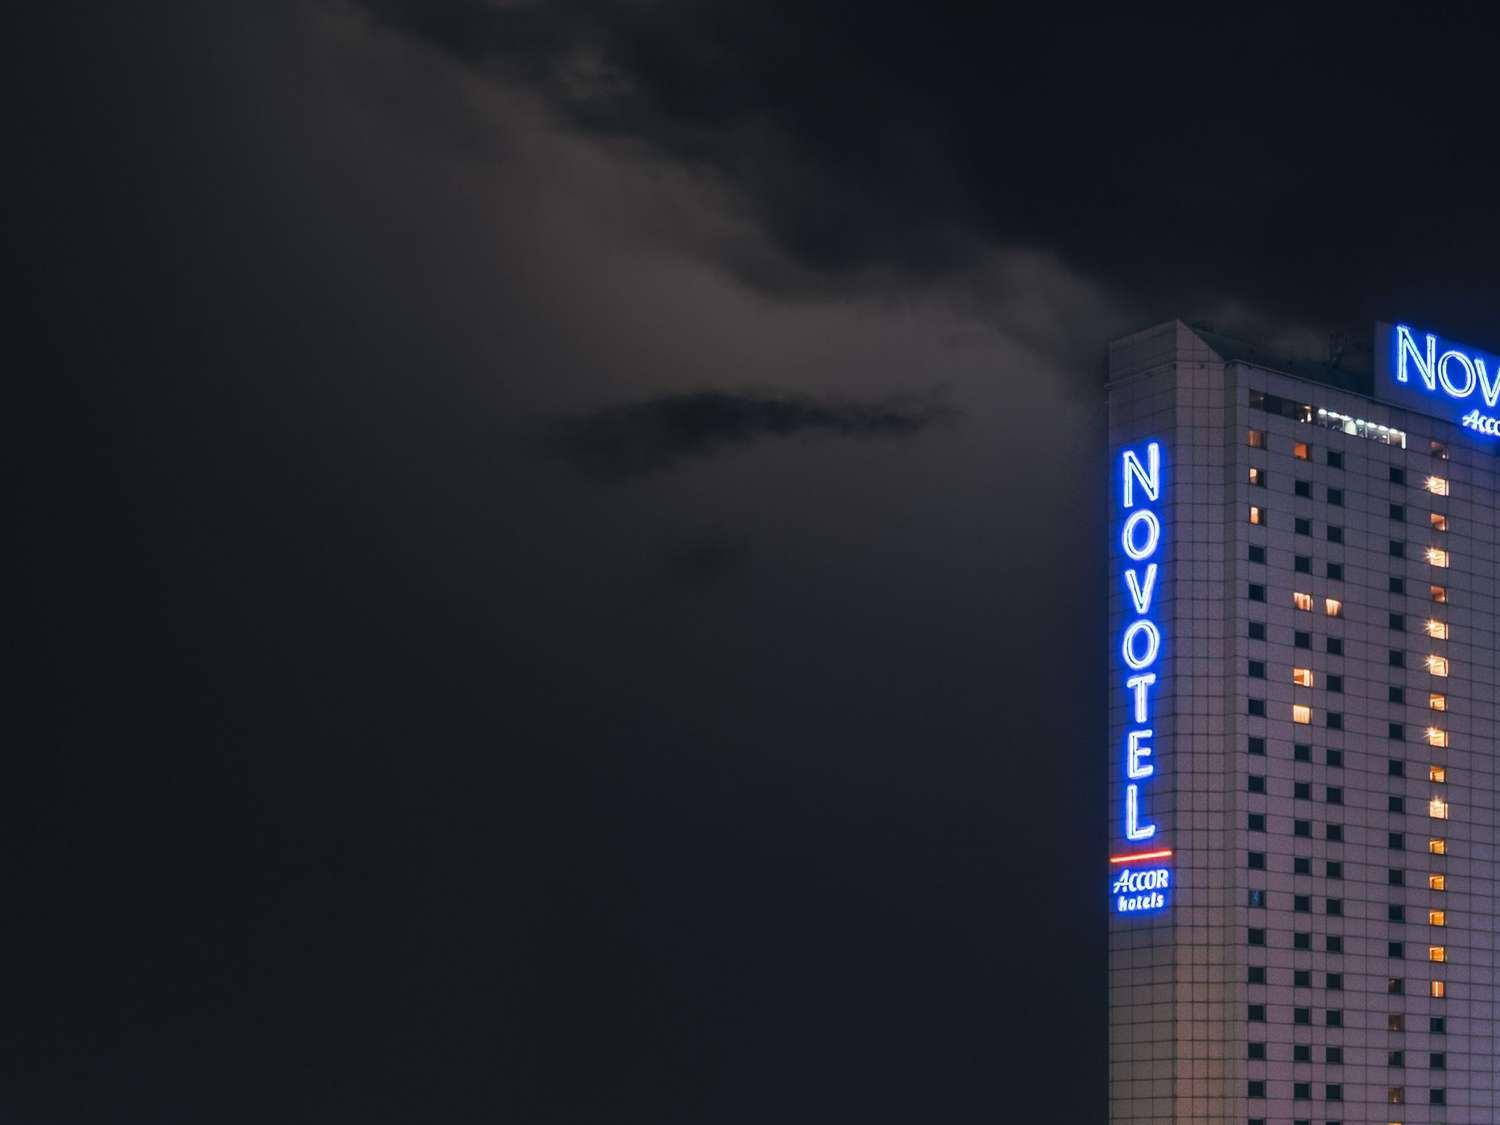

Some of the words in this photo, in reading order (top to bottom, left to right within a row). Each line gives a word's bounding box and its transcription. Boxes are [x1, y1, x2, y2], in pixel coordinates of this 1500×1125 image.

[1121, 442, 1161, 841] NOVOTEL
[1112, 869, 1169, 894] ACCOR
[1117, 892, 1165, 912] hotels
